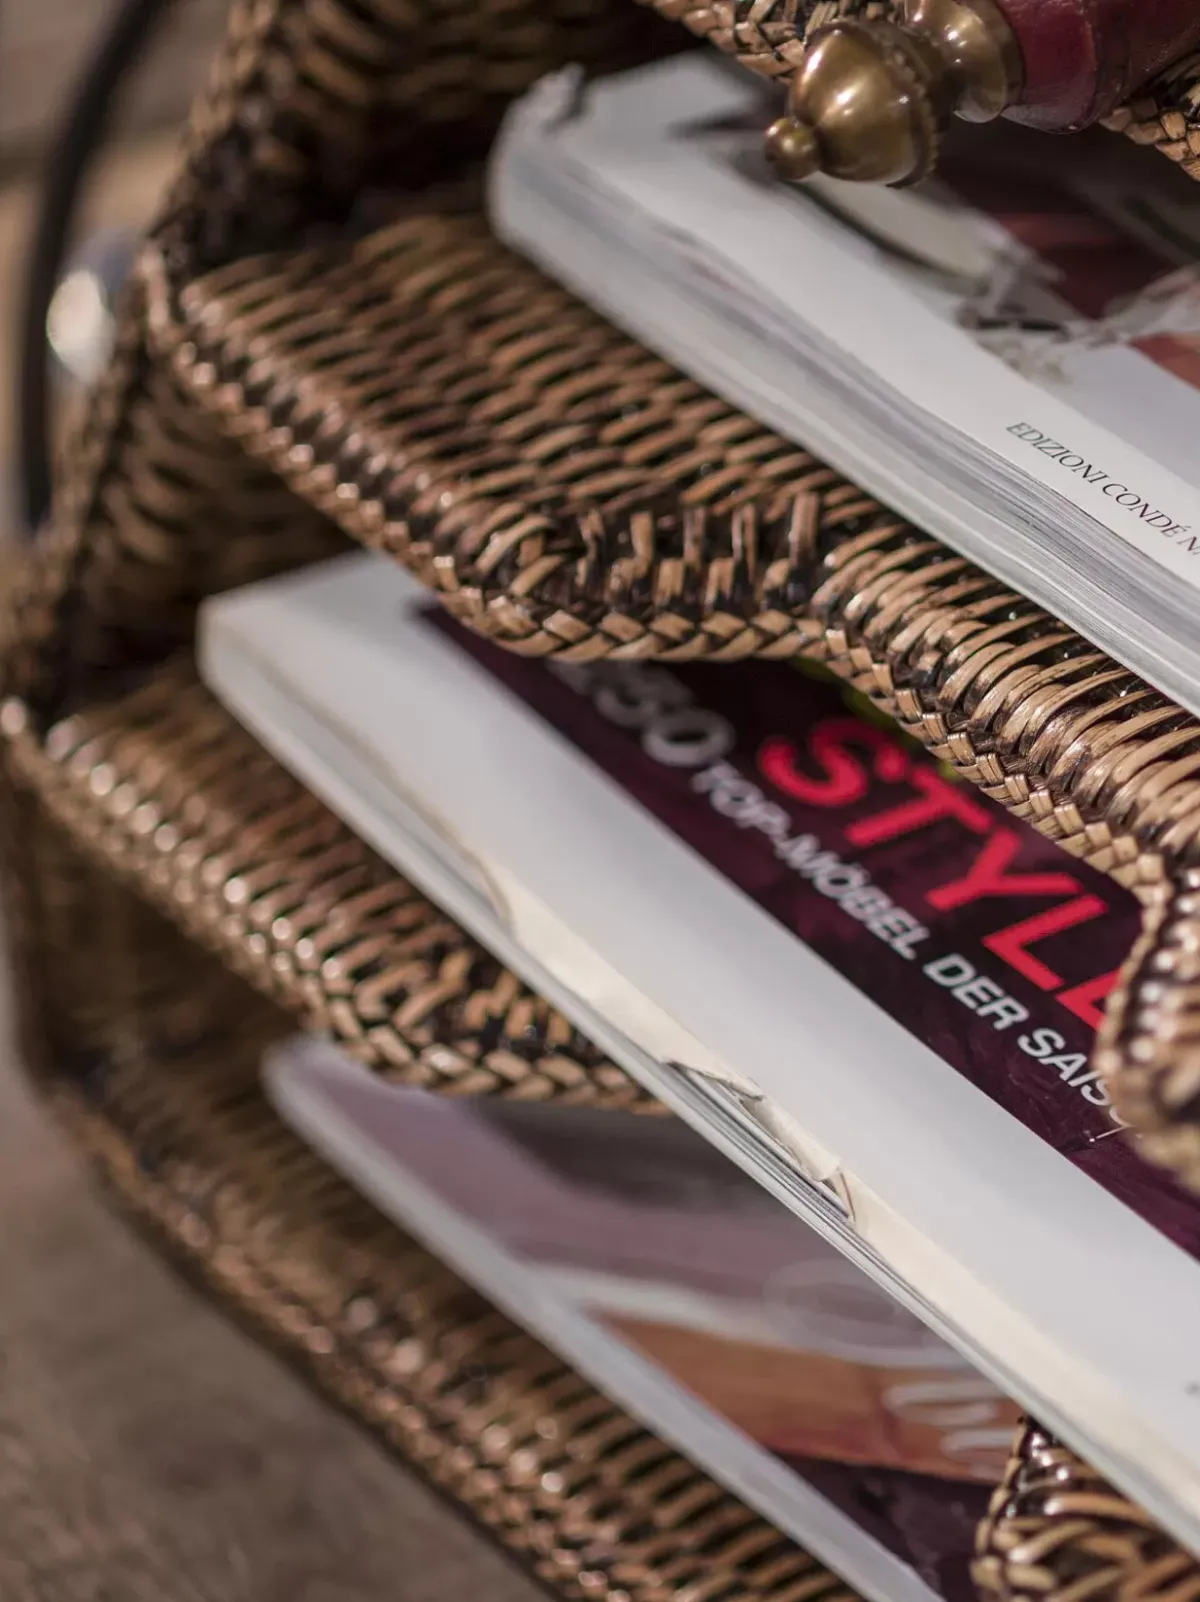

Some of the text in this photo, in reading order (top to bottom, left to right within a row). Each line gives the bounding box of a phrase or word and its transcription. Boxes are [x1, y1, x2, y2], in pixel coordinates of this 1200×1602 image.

[1005, 421, 1111, 484] EDIZIONI
[1102, 482, 1192, 539] CONDÉ
[922, 952, 1029, 1031] DER
[1017, 1027, 1130, 1128] SAIS
